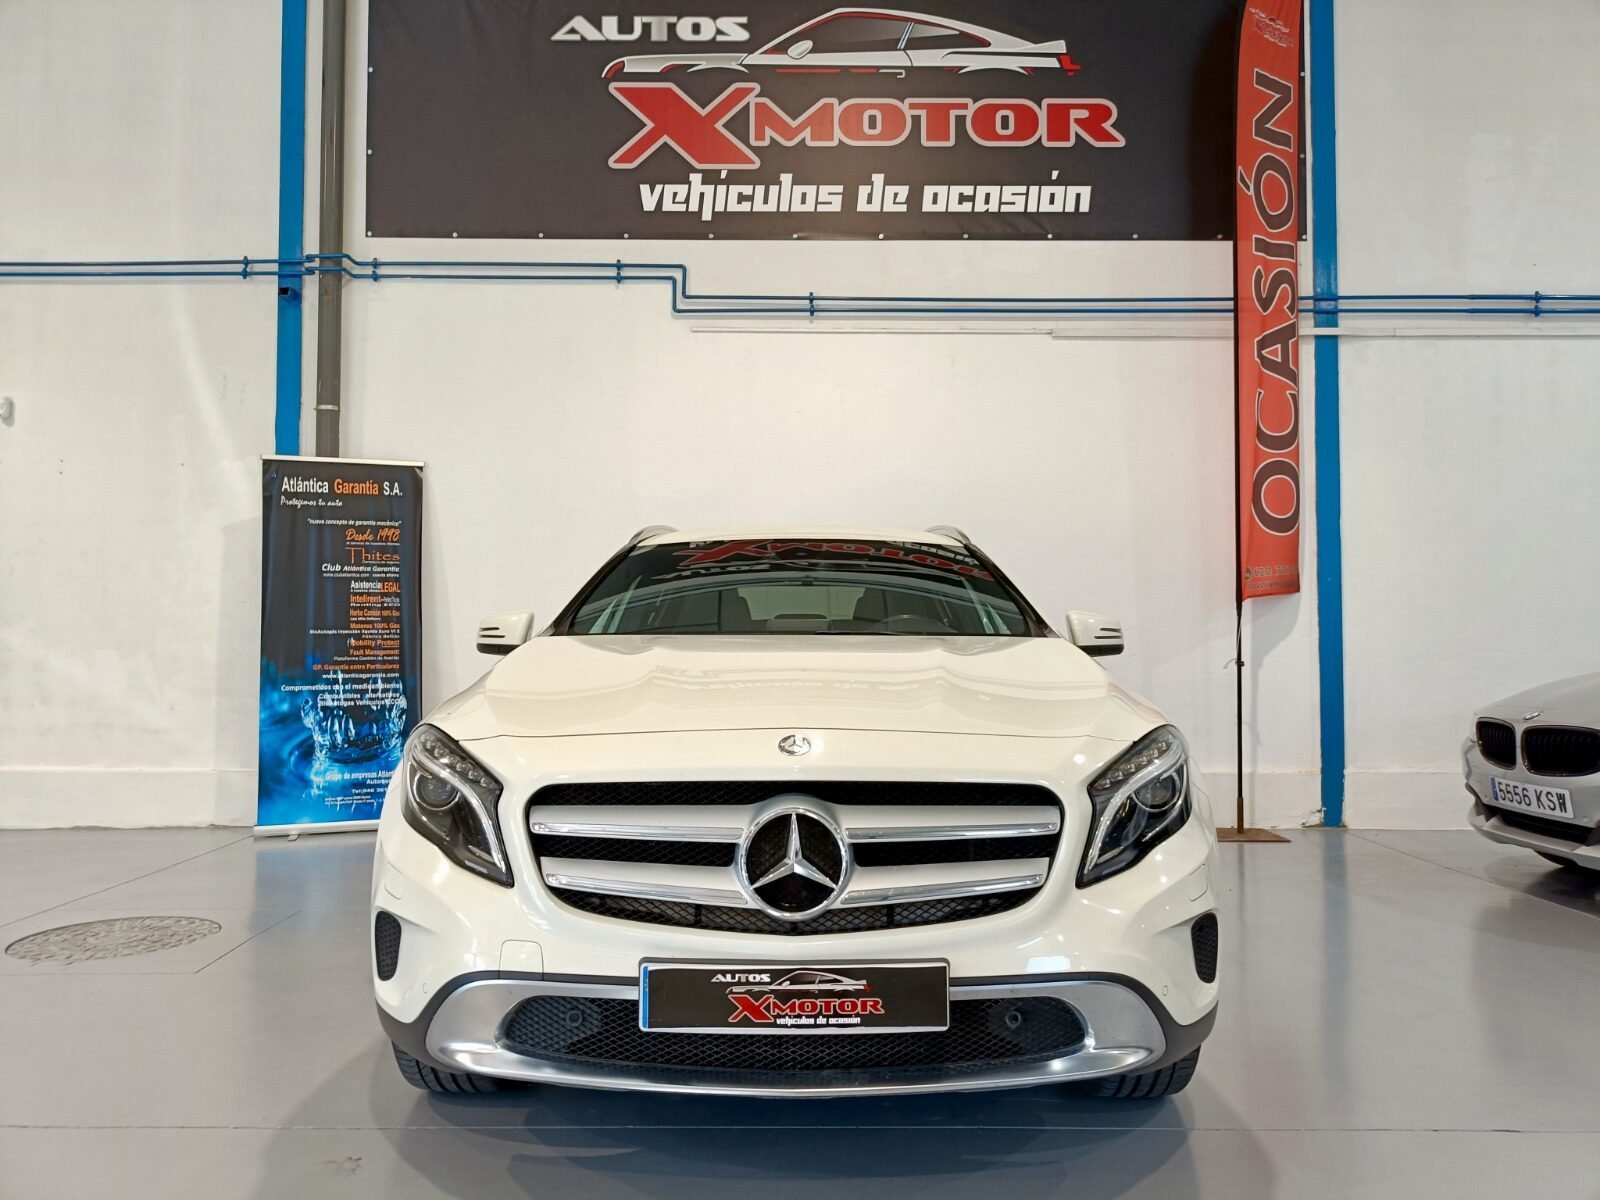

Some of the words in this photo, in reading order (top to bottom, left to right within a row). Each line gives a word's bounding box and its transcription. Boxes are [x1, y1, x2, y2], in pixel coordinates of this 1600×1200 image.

[550, 15, 751, 42] AUTOS
[608, 81, 1126, 169] XMOTOR
[639, 170, 843, 221] vehículos
[856, 173, 909, 212] de
[922, 170, 1091, 213] ocasión
[1237, 67, 1300, 536] OCASIÓN
[281, 476, 329, 493] Atlántica
[383, 481, 403, 496] S.A.
[345, 528, 374, 541] Desde
[377, 528, 401, 541] 1998
[321, 562, 341, 572] Club
[1497, 781, 1531, 806] 5556
[1534, 788, 1567, 813] KSW
[711, 973, 771, 983] AUTOS
[728, 994, 885, 1022] XMOTOR
[776, 1015, 815, 1026] vehículos
[816, 1016, 827, 1025] de
[828, 1015, 861, 1025] ocasión
